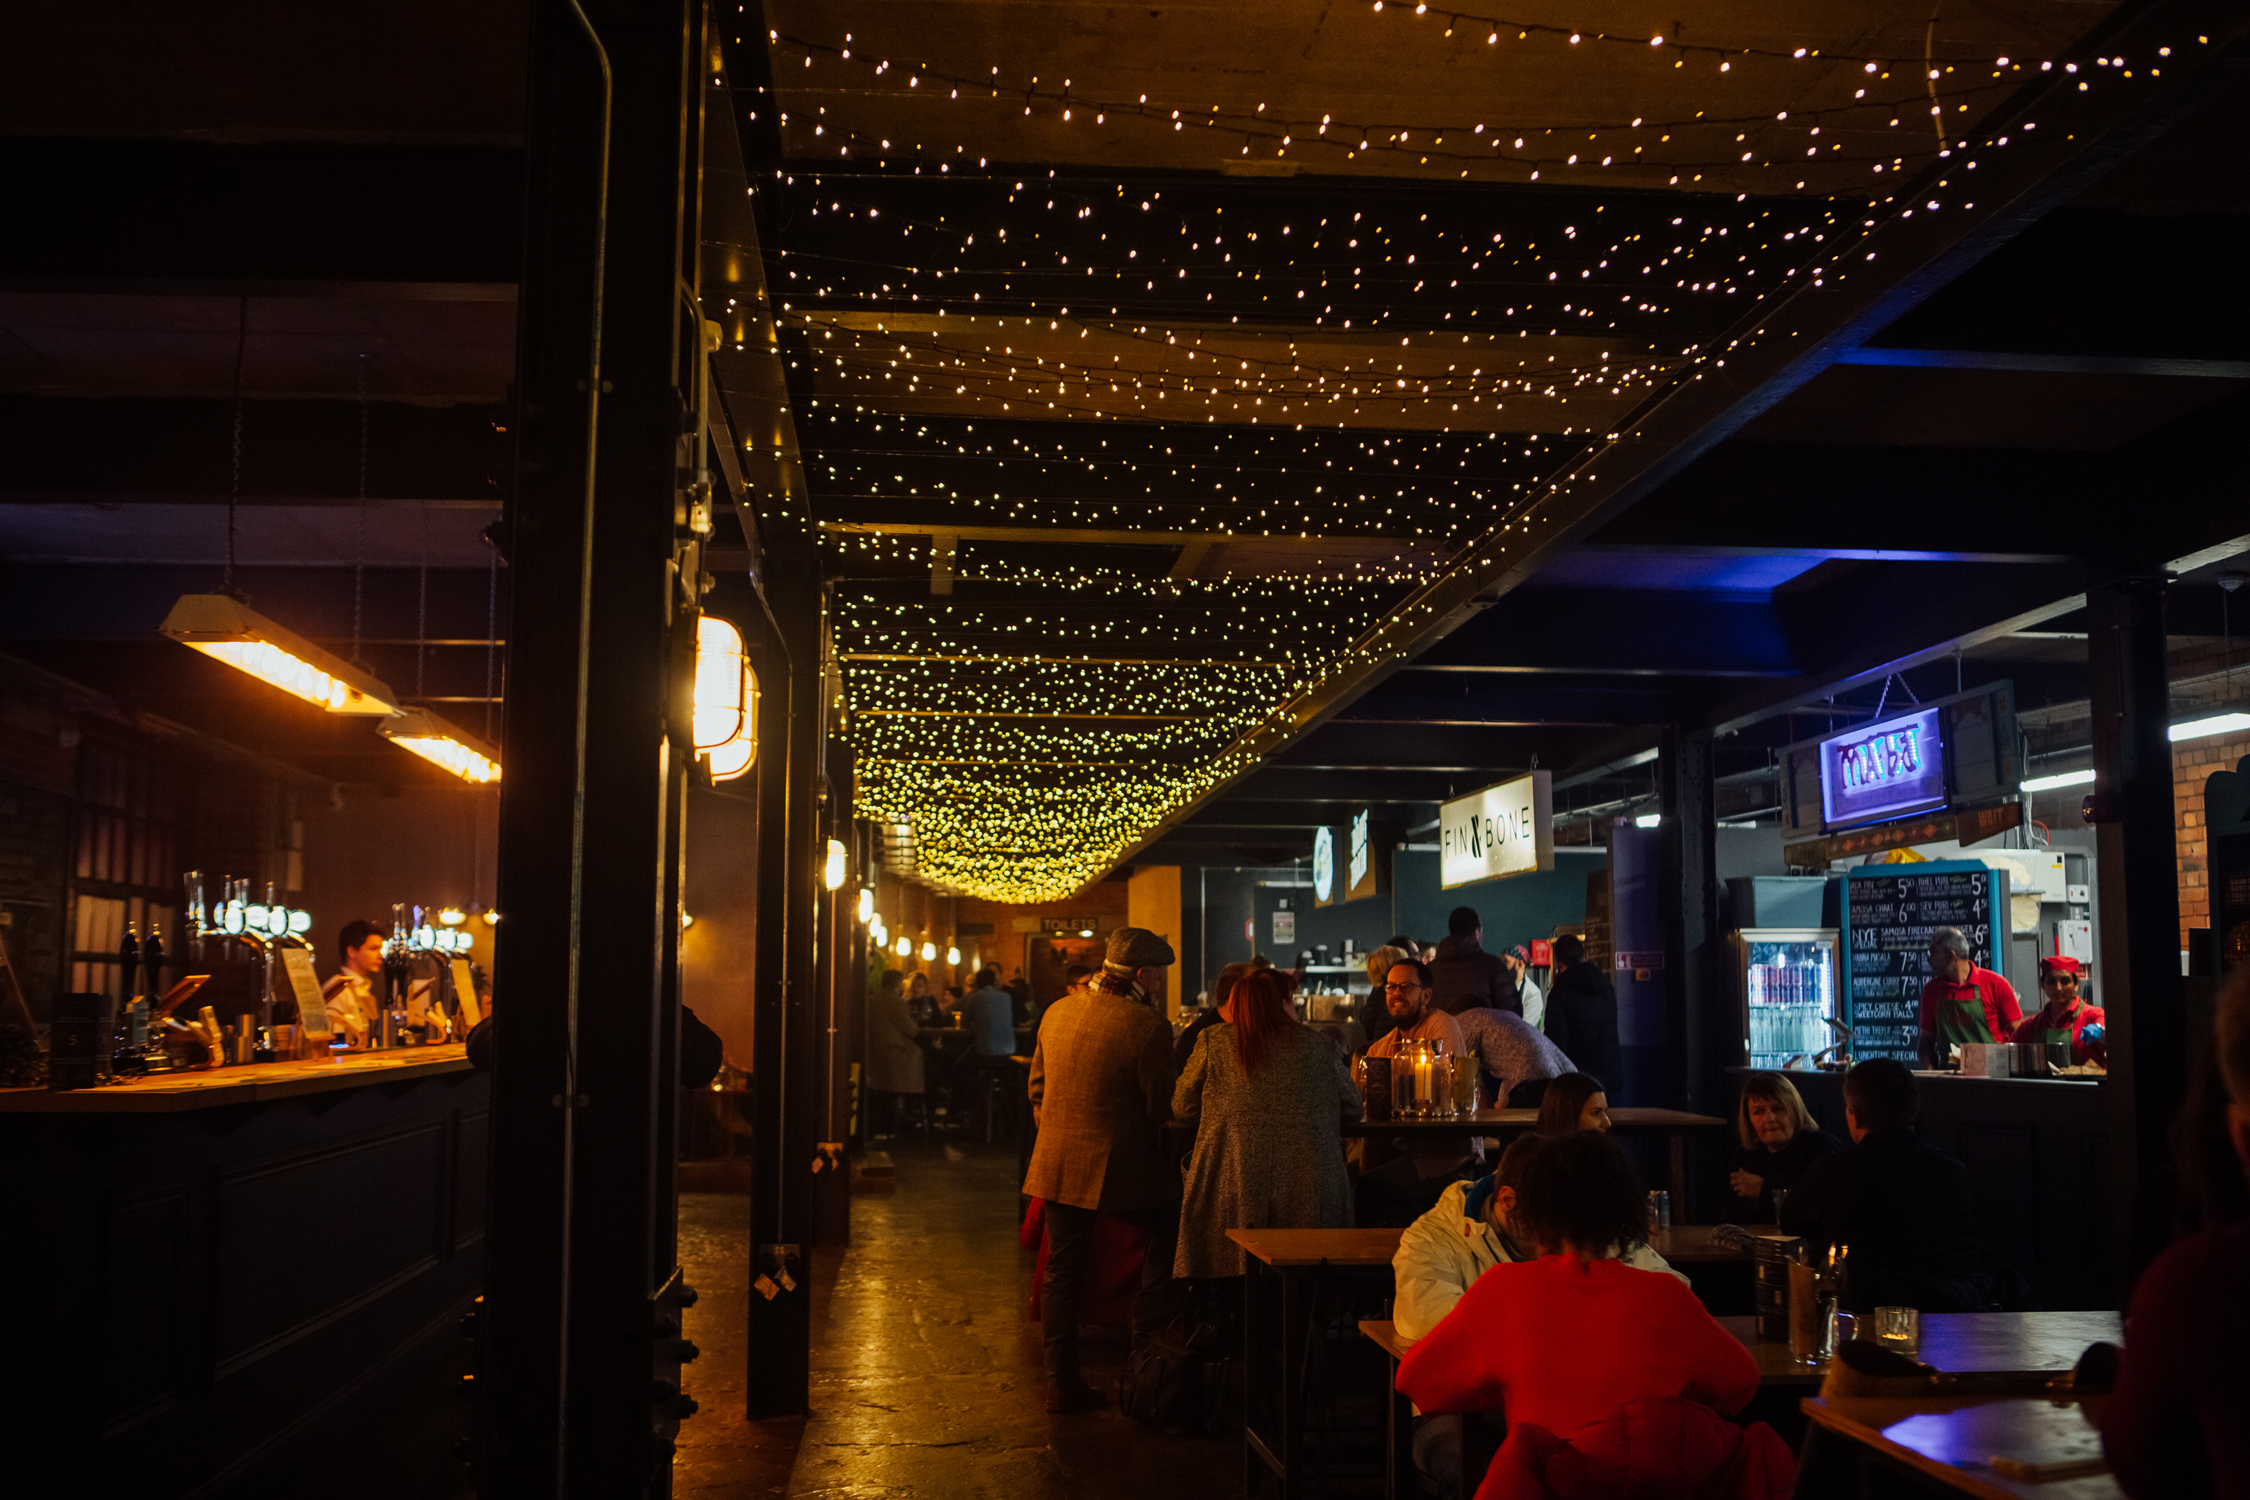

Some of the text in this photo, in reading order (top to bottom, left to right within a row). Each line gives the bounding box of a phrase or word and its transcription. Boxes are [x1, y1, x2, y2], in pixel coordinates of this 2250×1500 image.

[1445, 825, 1468, 858] FIN
[1485, 806, 1529, 848] BONE
[1043, 919, 1096, 931] TOILETS
[1852, 928, 1878, 941] NYE
[1881, 926, 1906, 937] SAMOSA
[1852, 940, 1878, 949] SPECIAL
[1853, 1001, 1873, 1011] SPICY
[1874, 1001, 1900, 1011] CHEESE
[1891, 1050, 1919, 1061] SPECIAL
